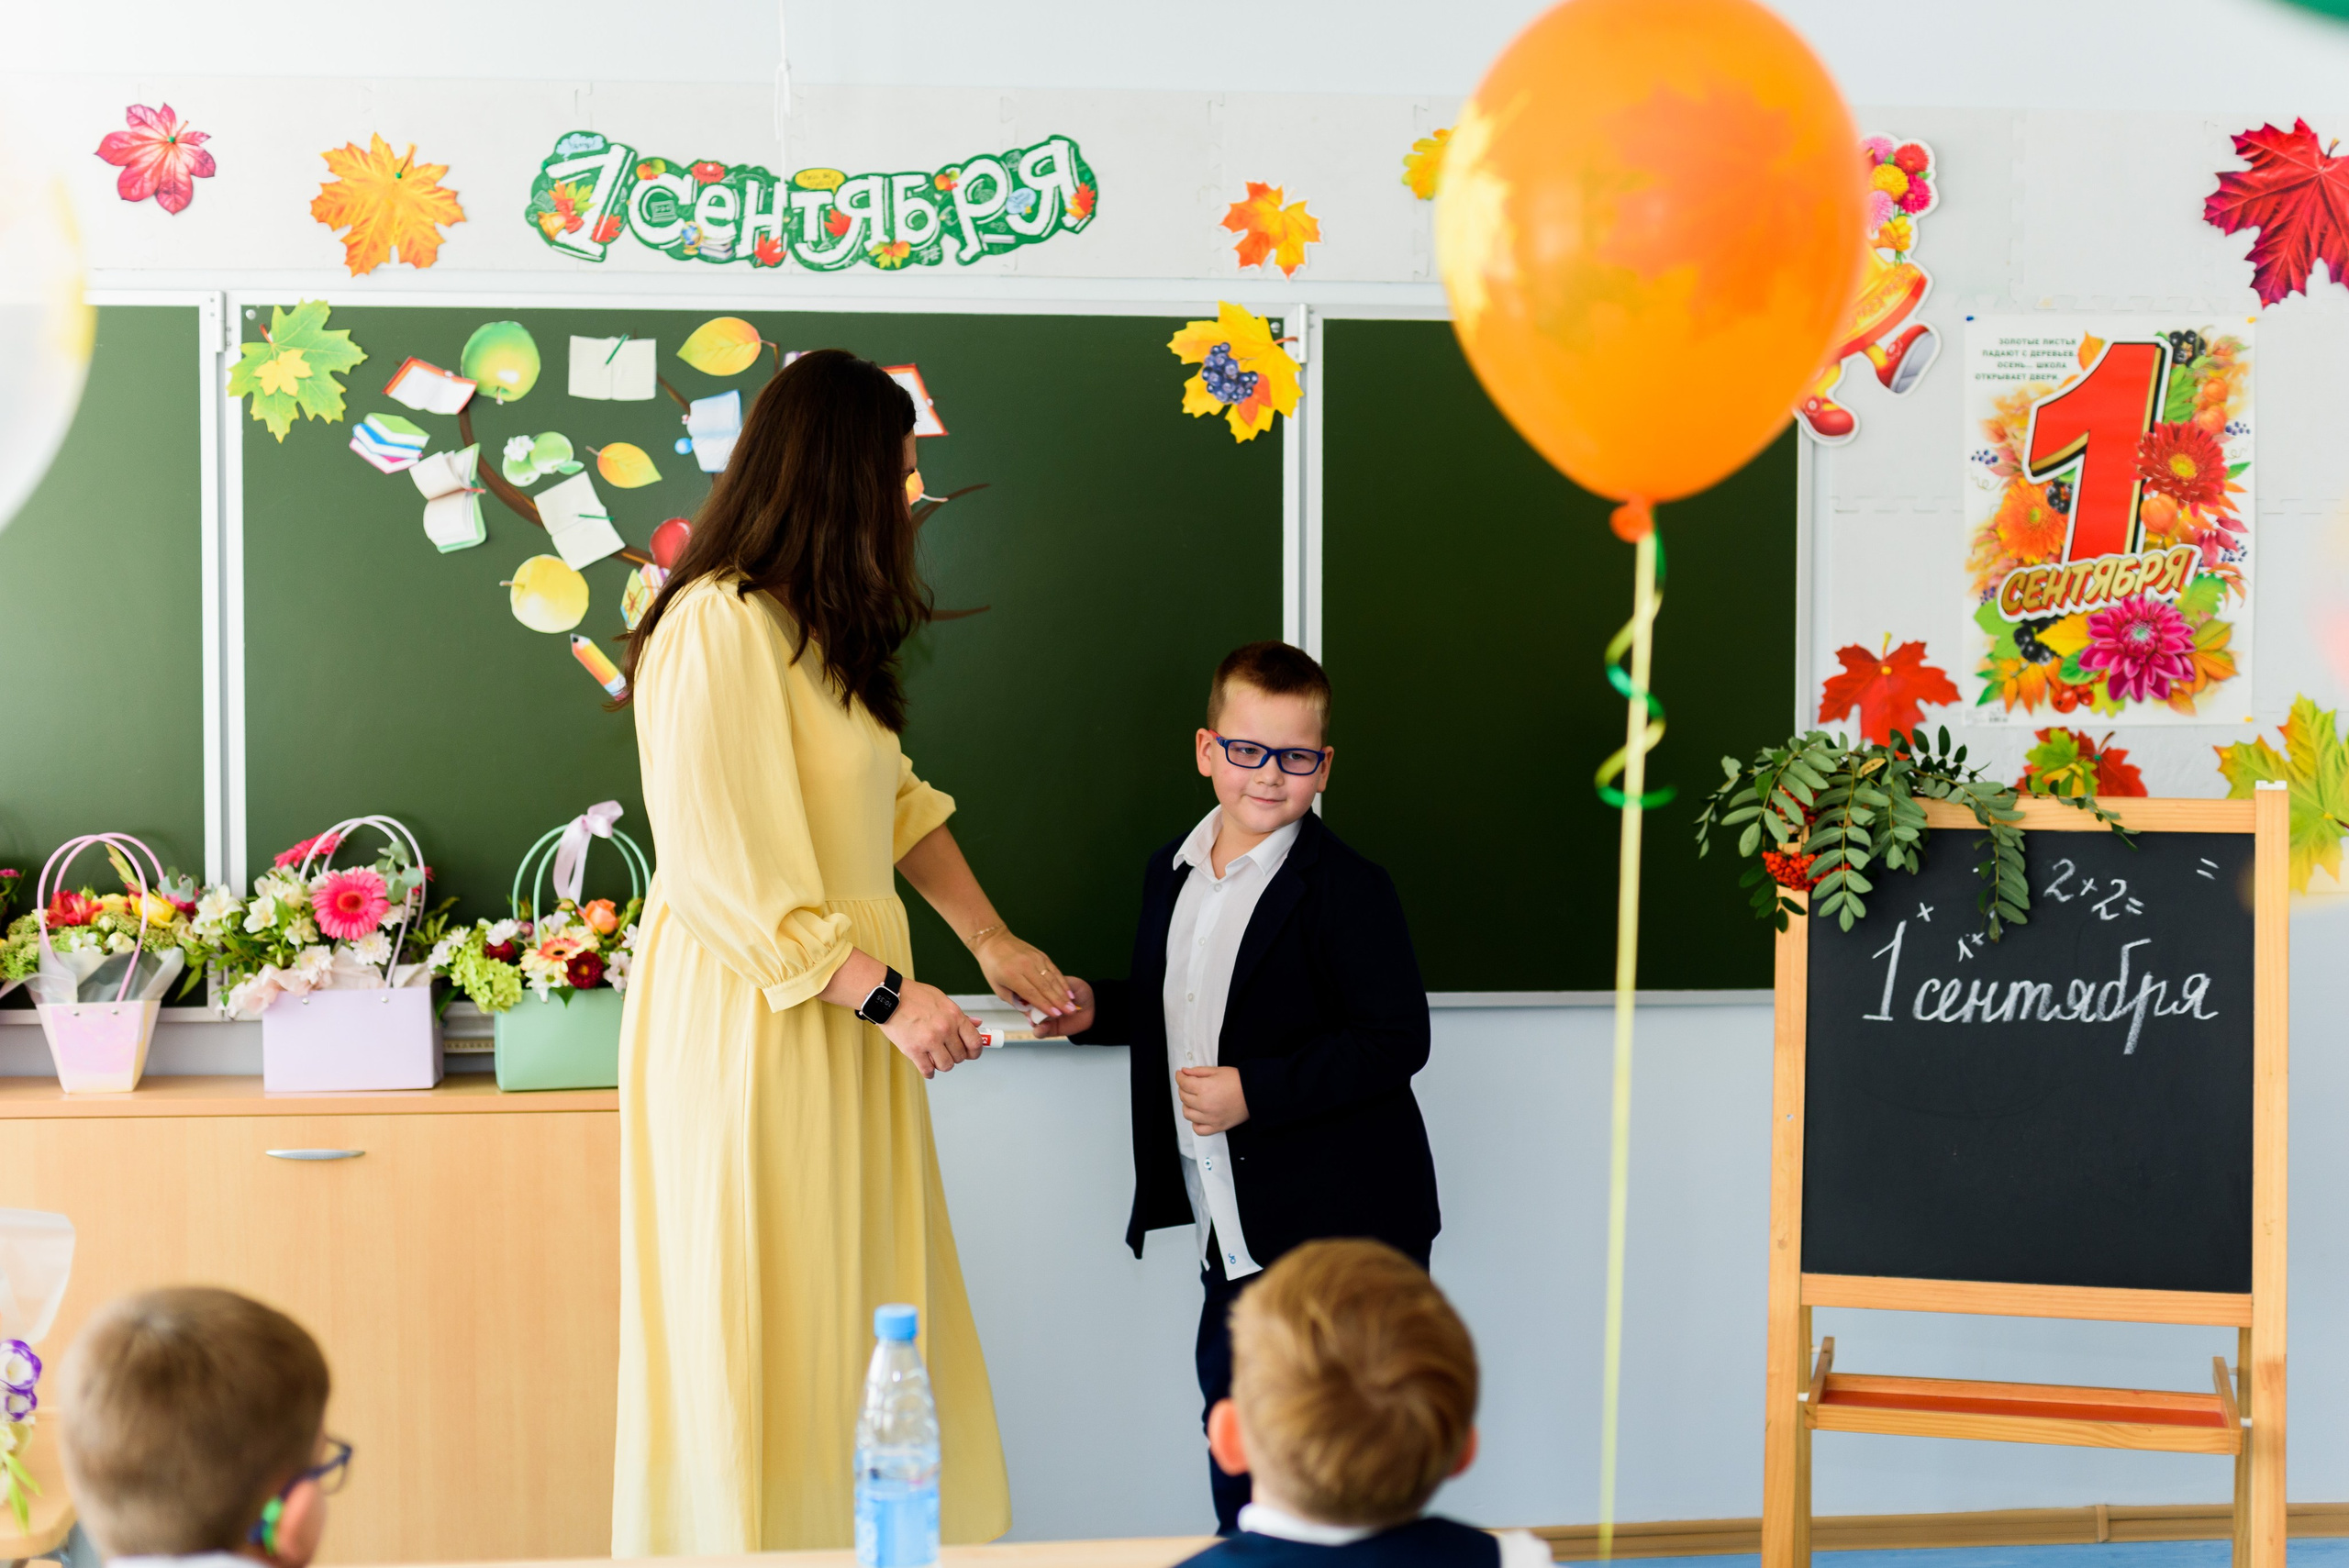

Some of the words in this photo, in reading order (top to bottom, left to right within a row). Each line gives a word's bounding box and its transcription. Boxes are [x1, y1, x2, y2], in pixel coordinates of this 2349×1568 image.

[544, 143, 628, 259] 1
[1975, 373, 2027, 381] ОТКРЫВАЕТ
[1982, 350, 2020, 358] ПАДАЮТ
[2036, 361, 2067, 369] ШКОЛА
[2029, 342, 2165, 562] 1
[2001, 548, 2196, 617] СЕНТЯБРЯ
[1862, 920, 1908, 1021] 1
[1912, 938, 2219, 1054] сентября
